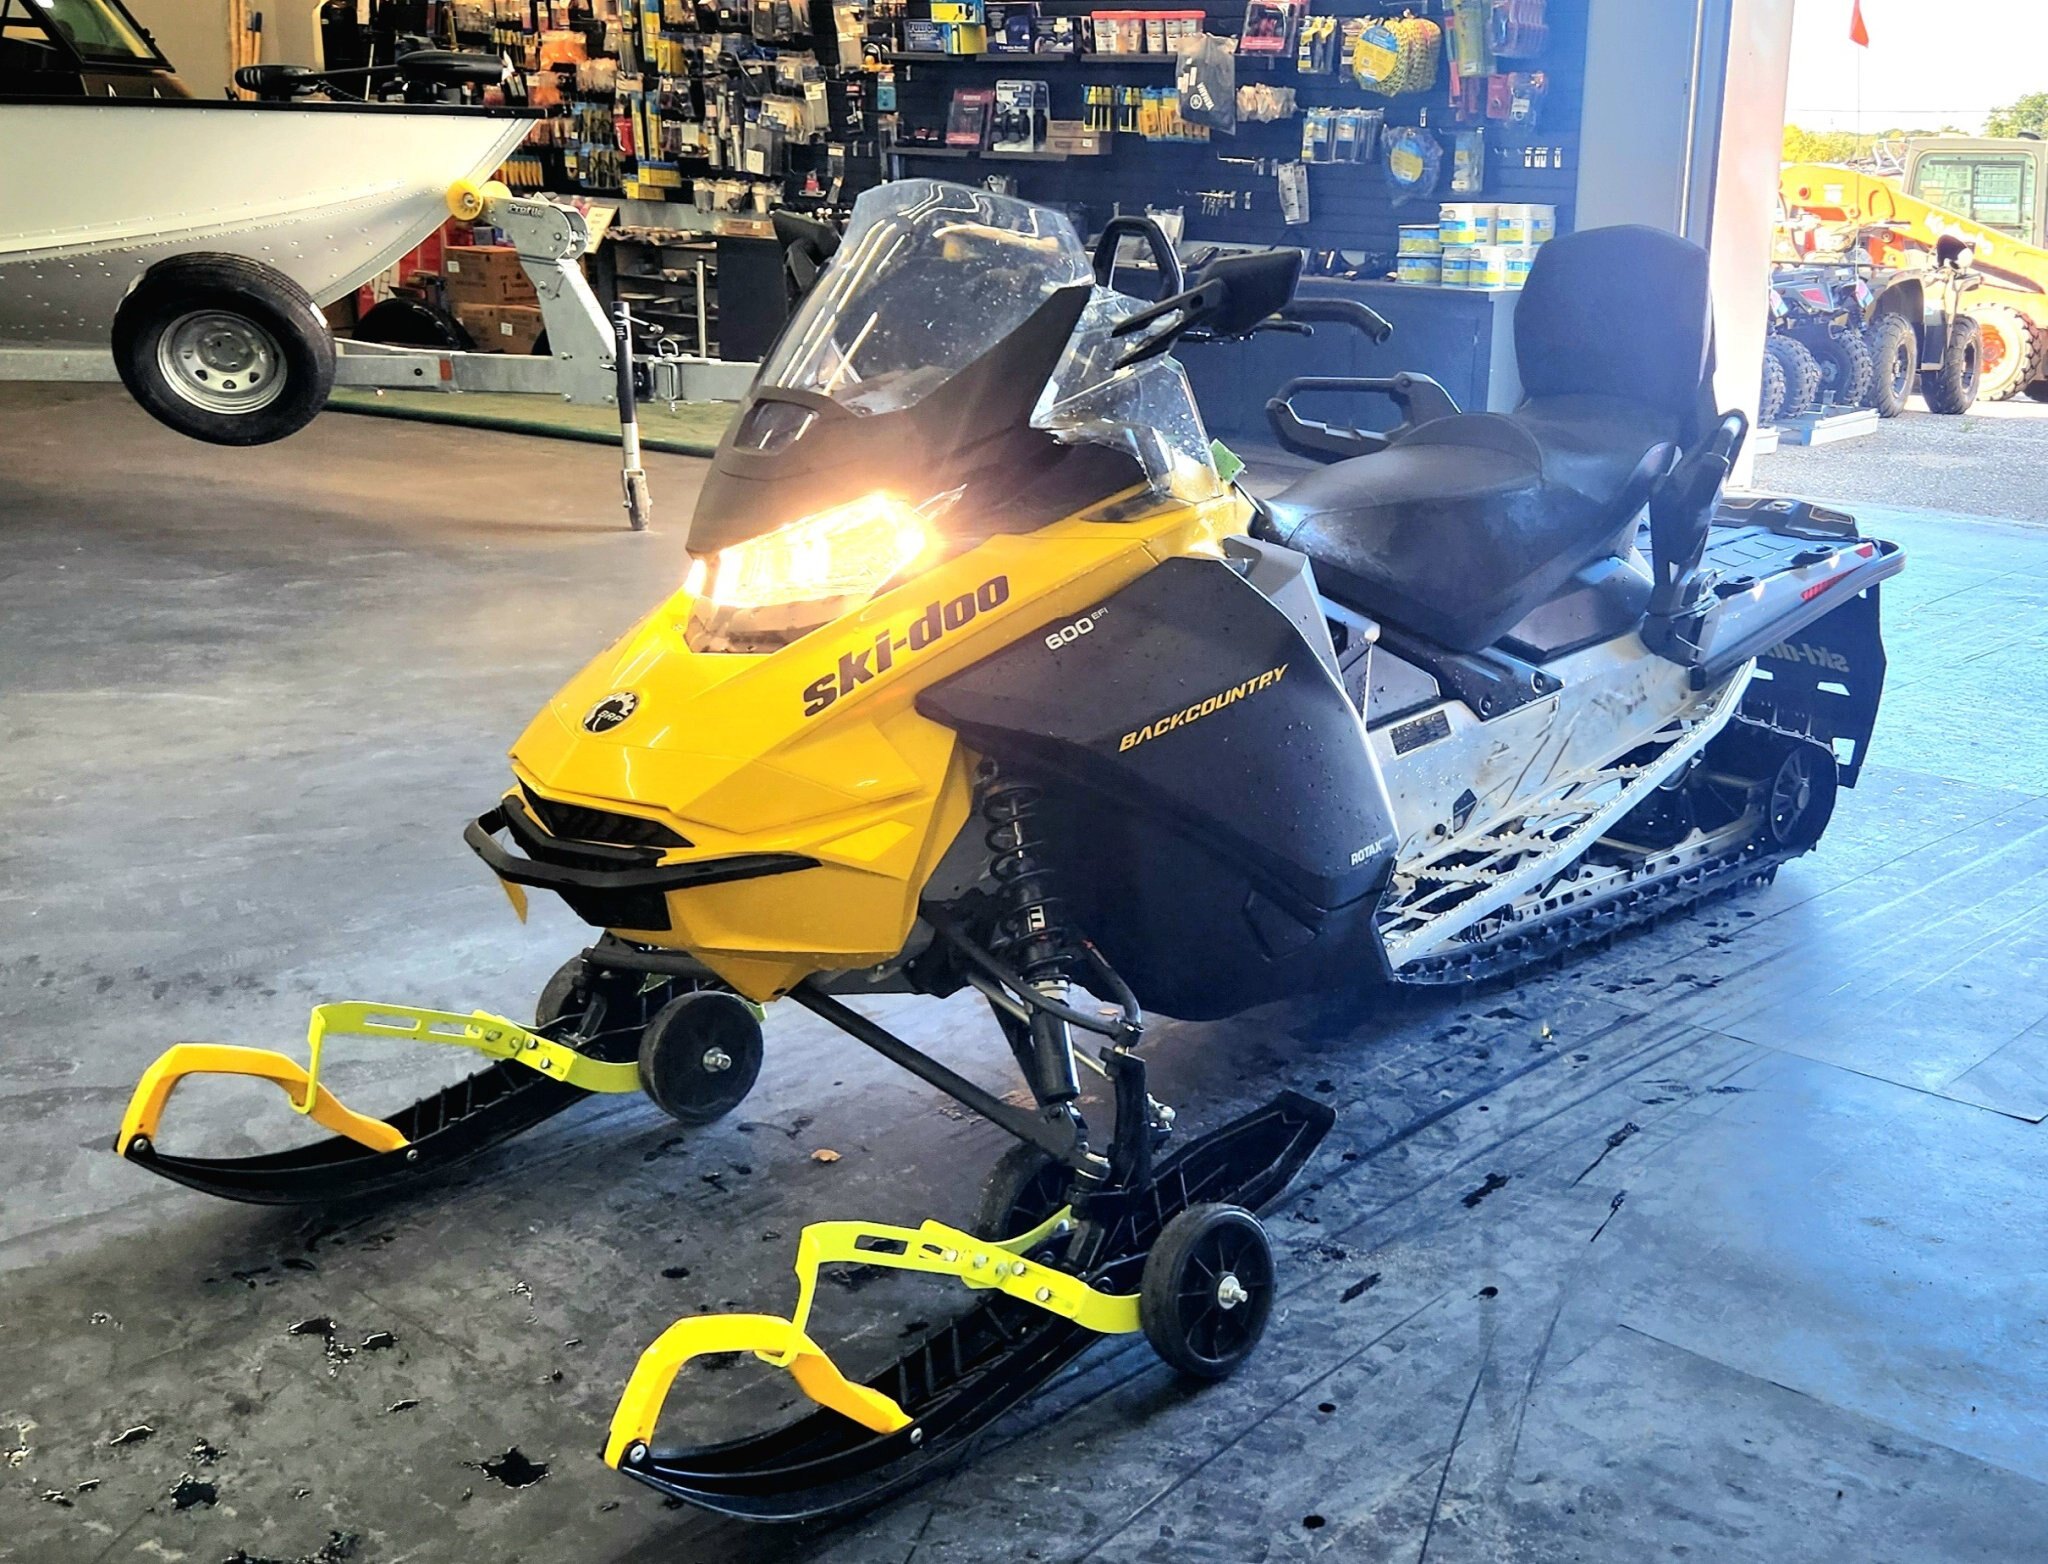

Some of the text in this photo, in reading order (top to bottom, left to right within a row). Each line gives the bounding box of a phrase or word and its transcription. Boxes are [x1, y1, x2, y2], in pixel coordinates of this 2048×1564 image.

[803, 575, 1010, 717] ski-doo
[1045, 607, 1109, 650] 600 EFI
[598, 710, 623, 722] BRP
[1119, 663, 1289, 752] BACKCOUNTRY
[1351, 841, 1382, 866] ROTAX
